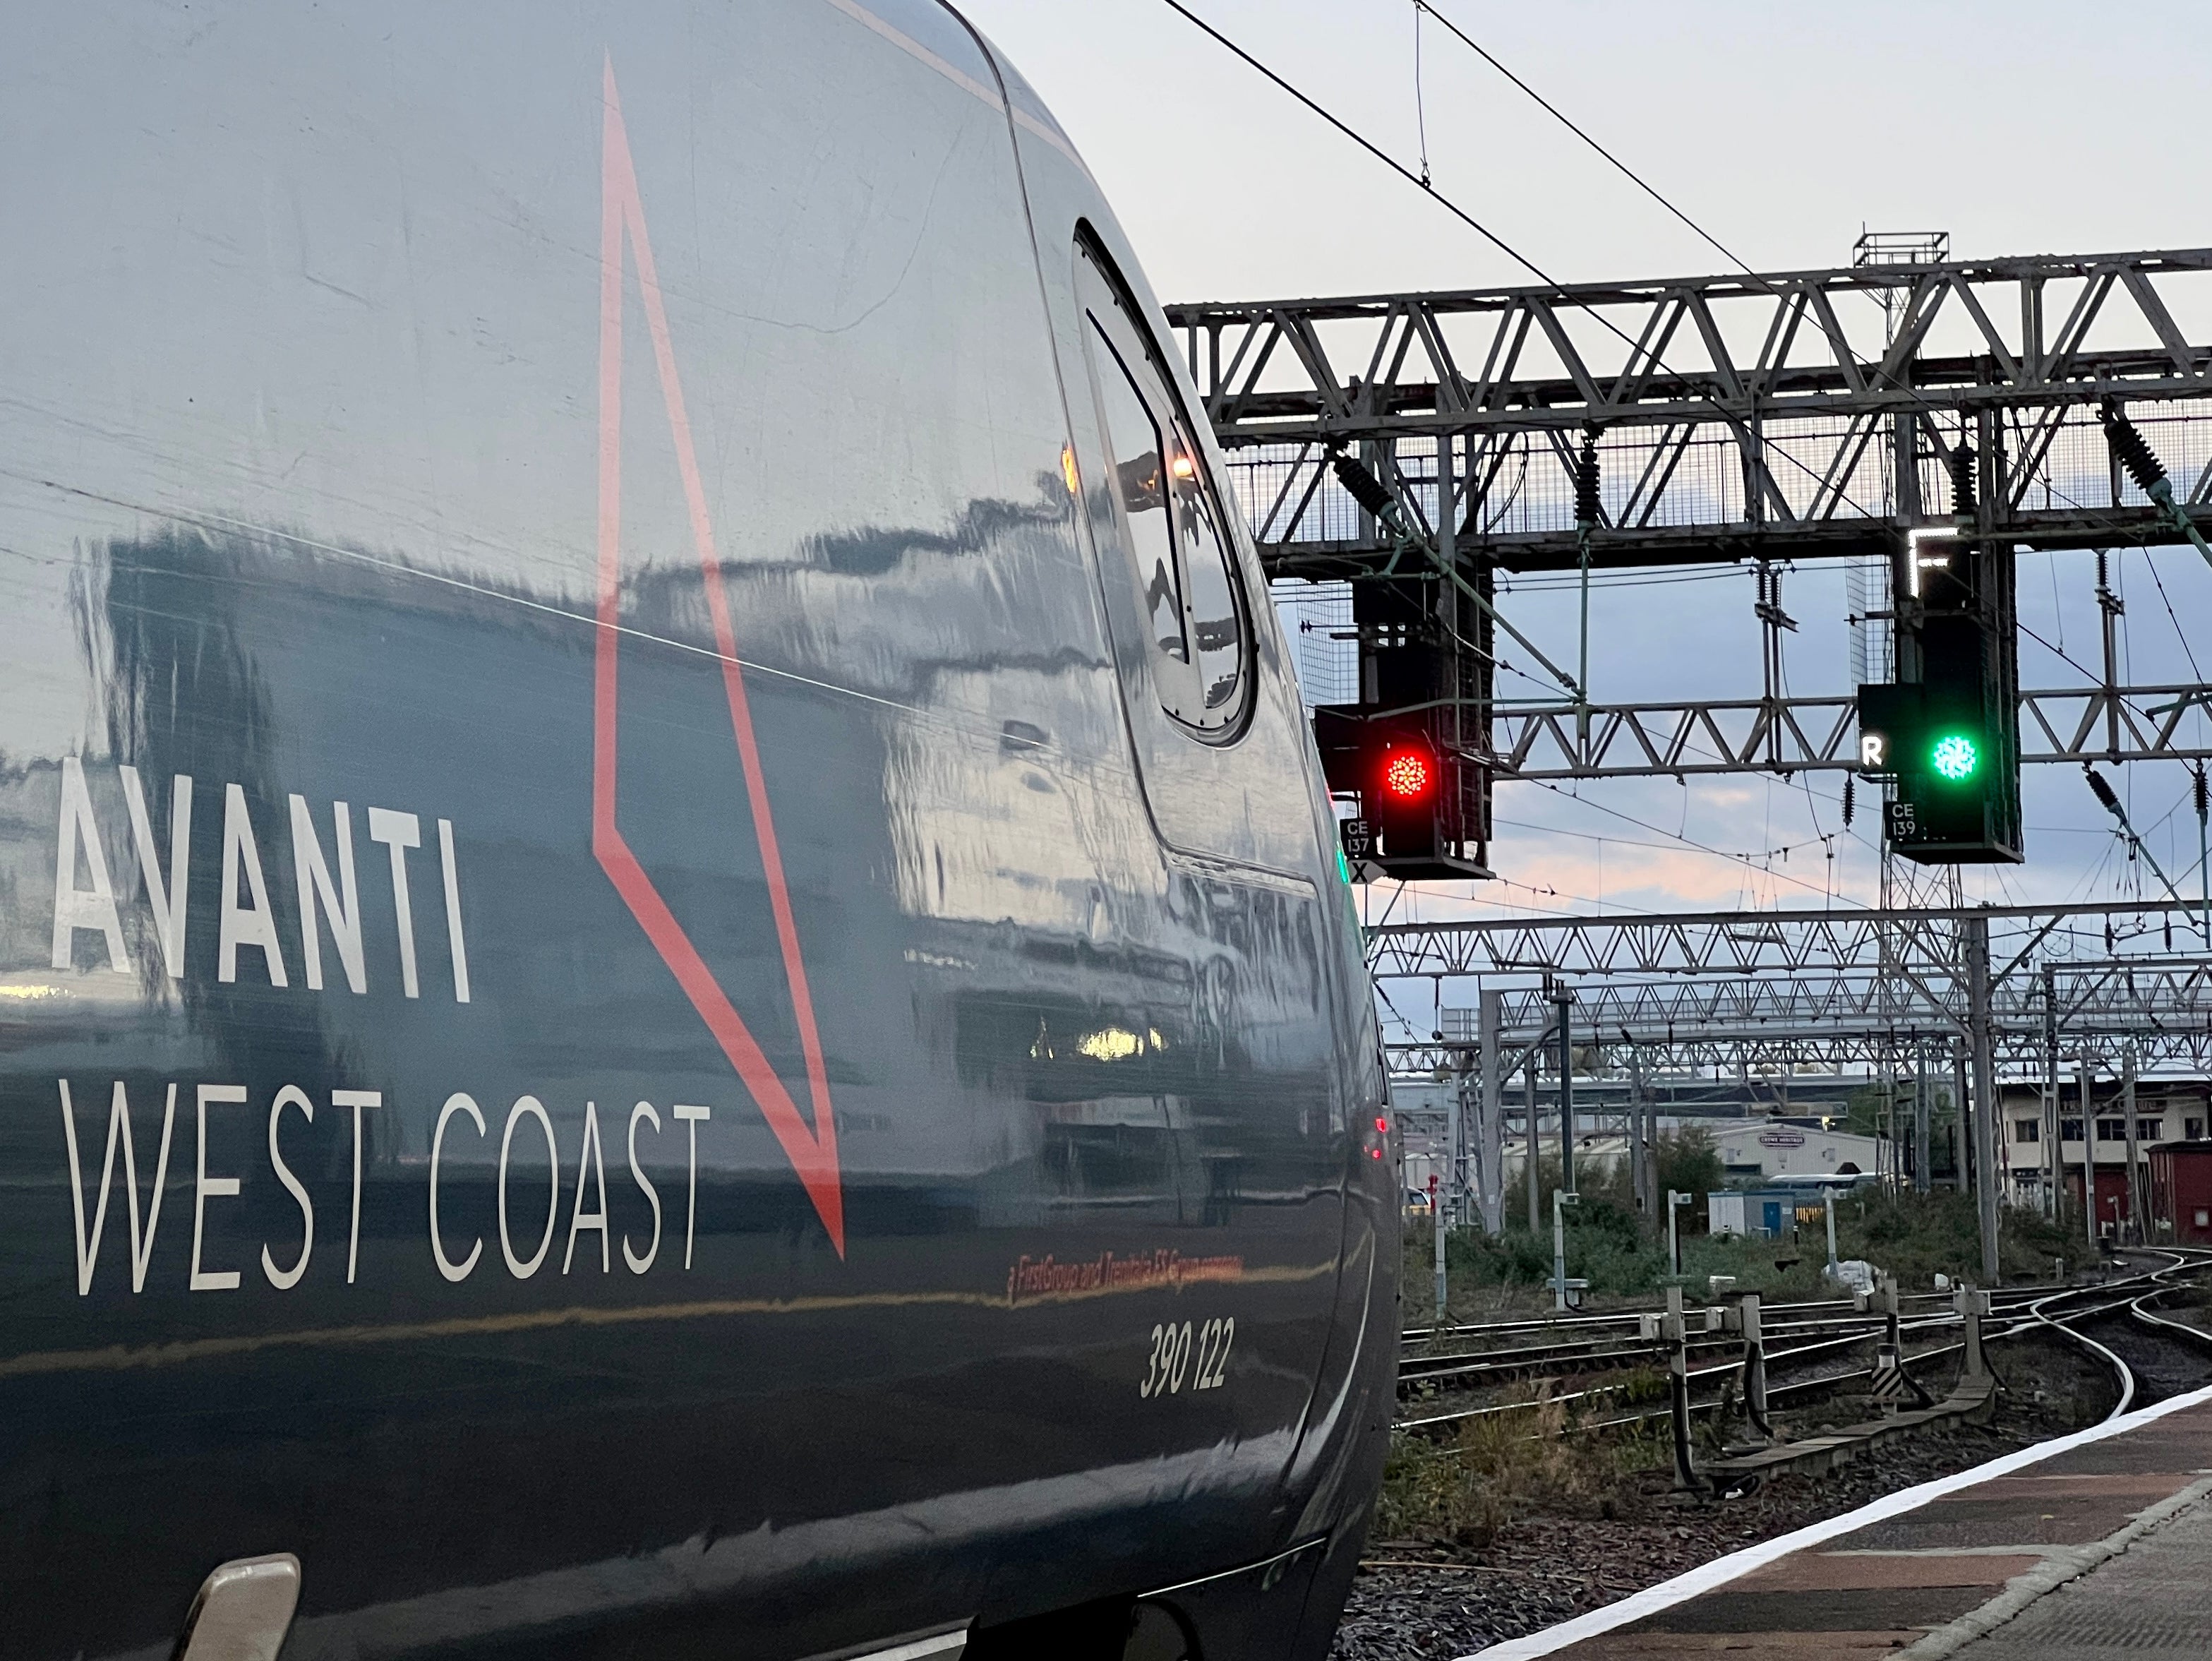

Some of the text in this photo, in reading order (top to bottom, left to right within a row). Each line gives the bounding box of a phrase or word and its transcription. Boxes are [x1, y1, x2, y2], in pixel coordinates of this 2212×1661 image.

[1909, 528, 1959, 599] F
[1862, 736, 1882, 766] R
[1892, 803, 1914, 818] CE
[1347, 820, 1368, 835] CE
[1893, 820, 1916, 836] 139
[1347, 837, 1369, 853] 137
[52, 756, 470, 1003] AVANTI
[1351, 862, 1368, 883] X
[59, 1079, 710, 1295] WEST COAST
[1017, 1254, 1078, 1293] FirstGroup
[1141, 1317, 1234, 1398] 390 122
